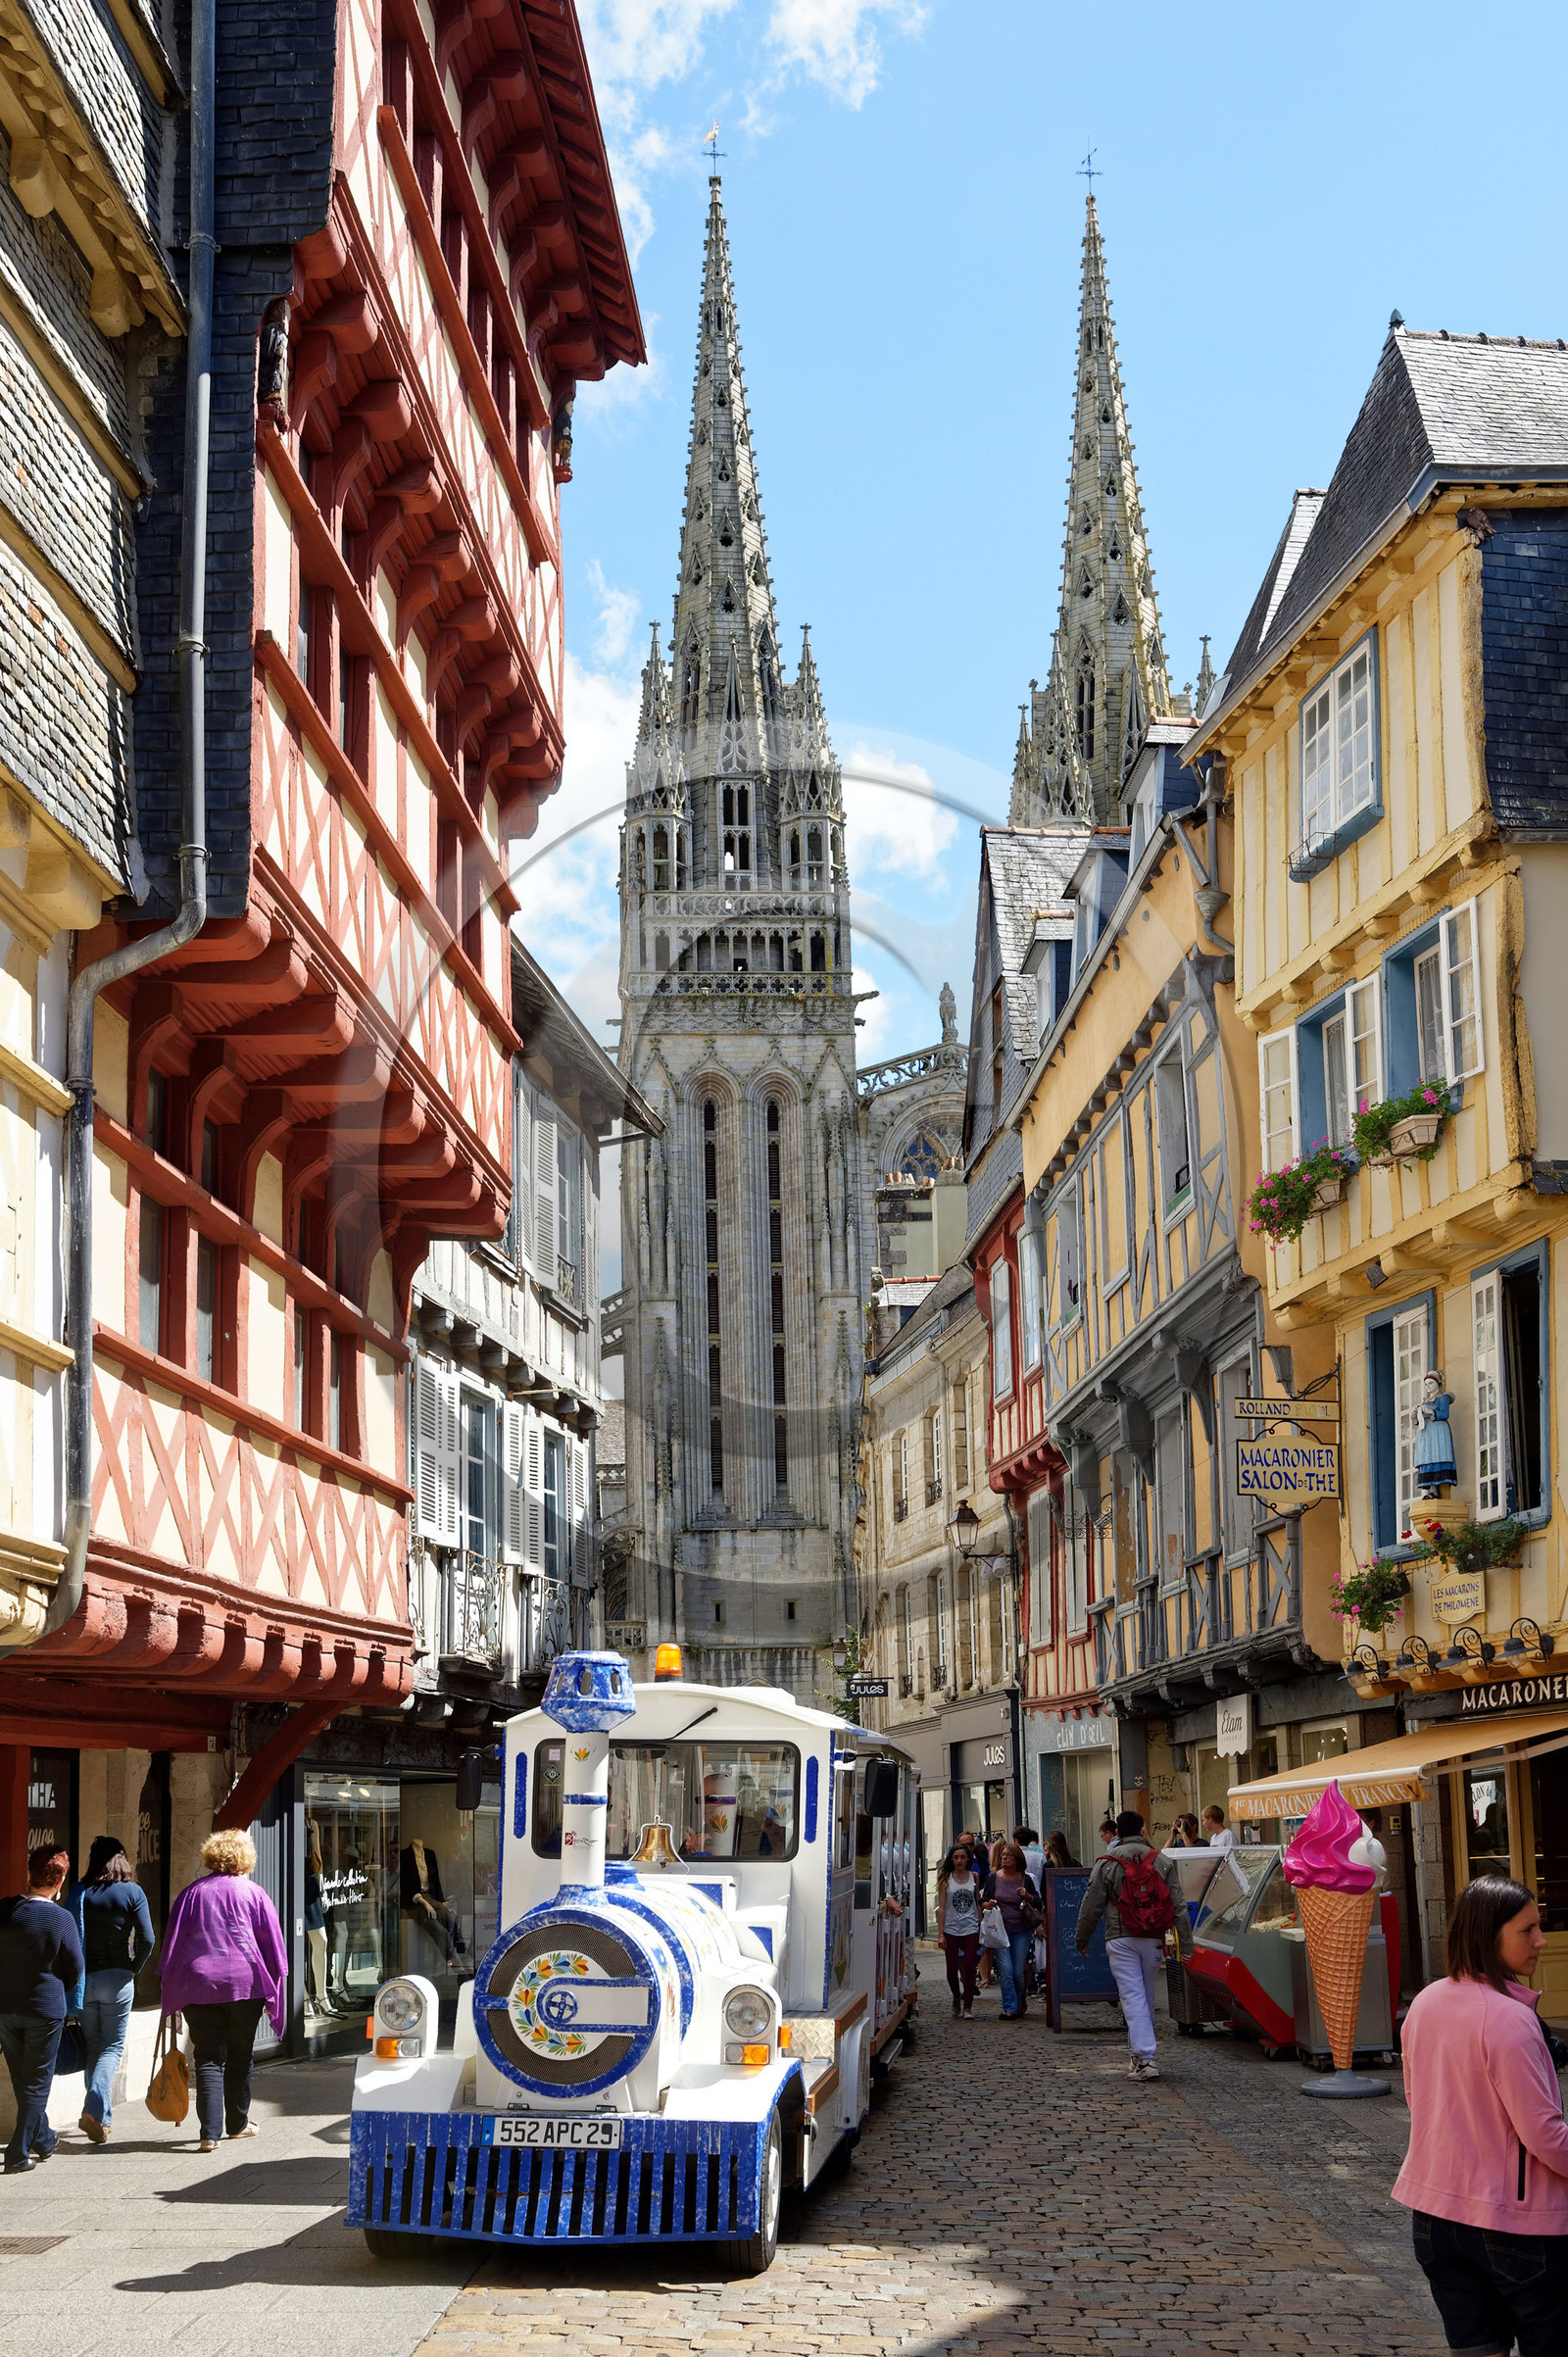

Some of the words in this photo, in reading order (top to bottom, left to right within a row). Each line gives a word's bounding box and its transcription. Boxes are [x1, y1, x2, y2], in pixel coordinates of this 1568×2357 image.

[1239, 1401, 1291, 1416] ROLLAND
[1241, 1448, 1335, 1468] MACARONIER
[1241, 1469, 1298, 1490] SALON
[1305, 1473, 1336, 1493] THE
[1433, 1588, 1444, 1599] LES
[1445, 1581, 1480, 1596] MACARONS
[1434, 1602, 1443, 1613] DE
[1462, 1676, 1568, 1710] MACARONE
[1221, 1709, 1243, 1735] Etam
[28, 1782, 56, 1808] THA
[500, 2121, 539, 2143] 552
[543, 2122, 582, 2144] APC
[586, 2123, 613, 2145] 29
